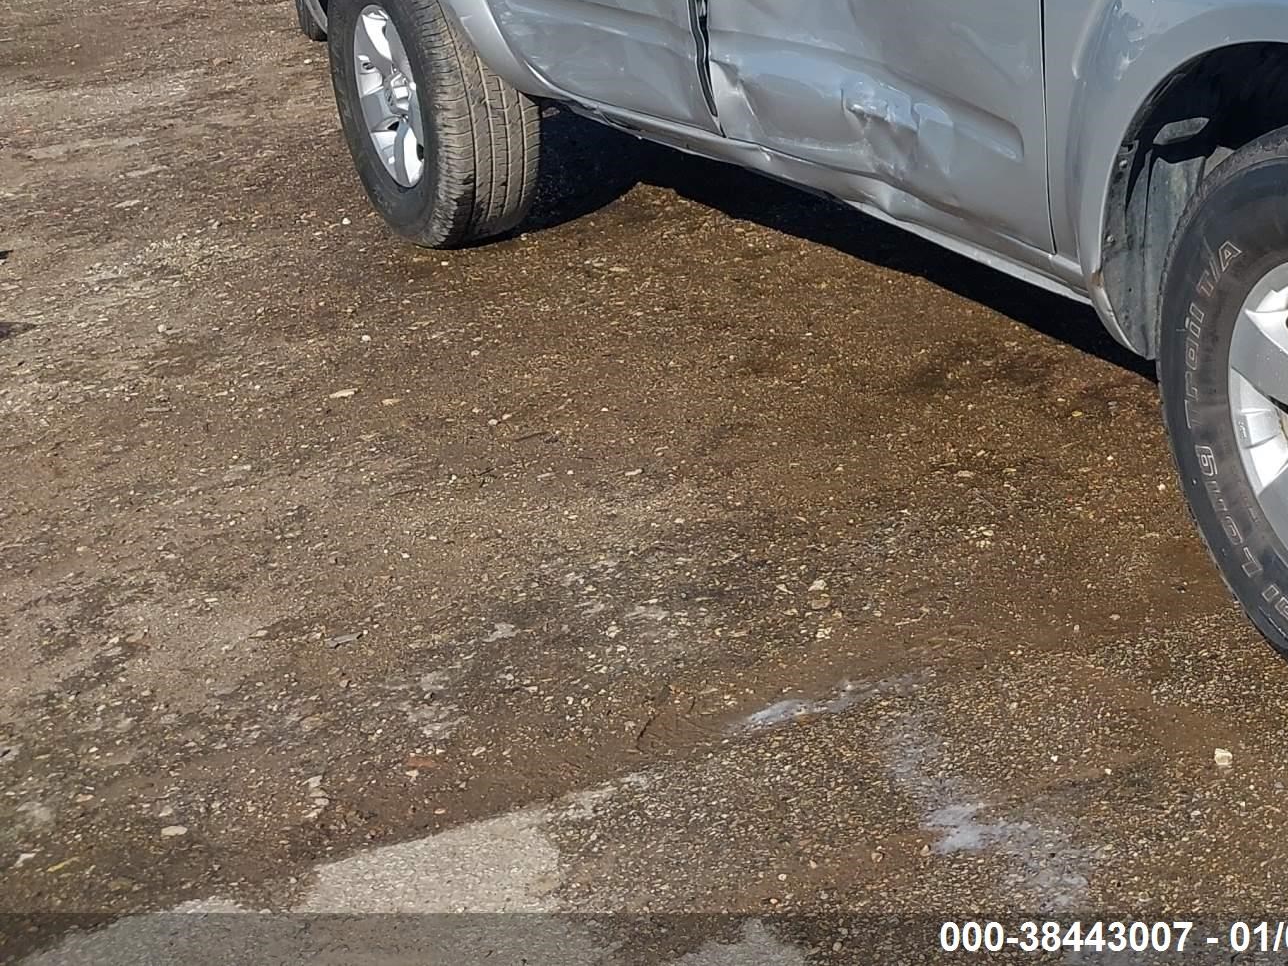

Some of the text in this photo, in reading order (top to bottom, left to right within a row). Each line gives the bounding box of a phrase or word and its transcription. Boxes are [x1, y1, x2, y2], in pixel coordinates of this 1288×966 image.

[1196, 240, 1242, 298] T/A
[1184, 302, 1205, 431] Trail
[1195, 445, 1263, 578] Long
